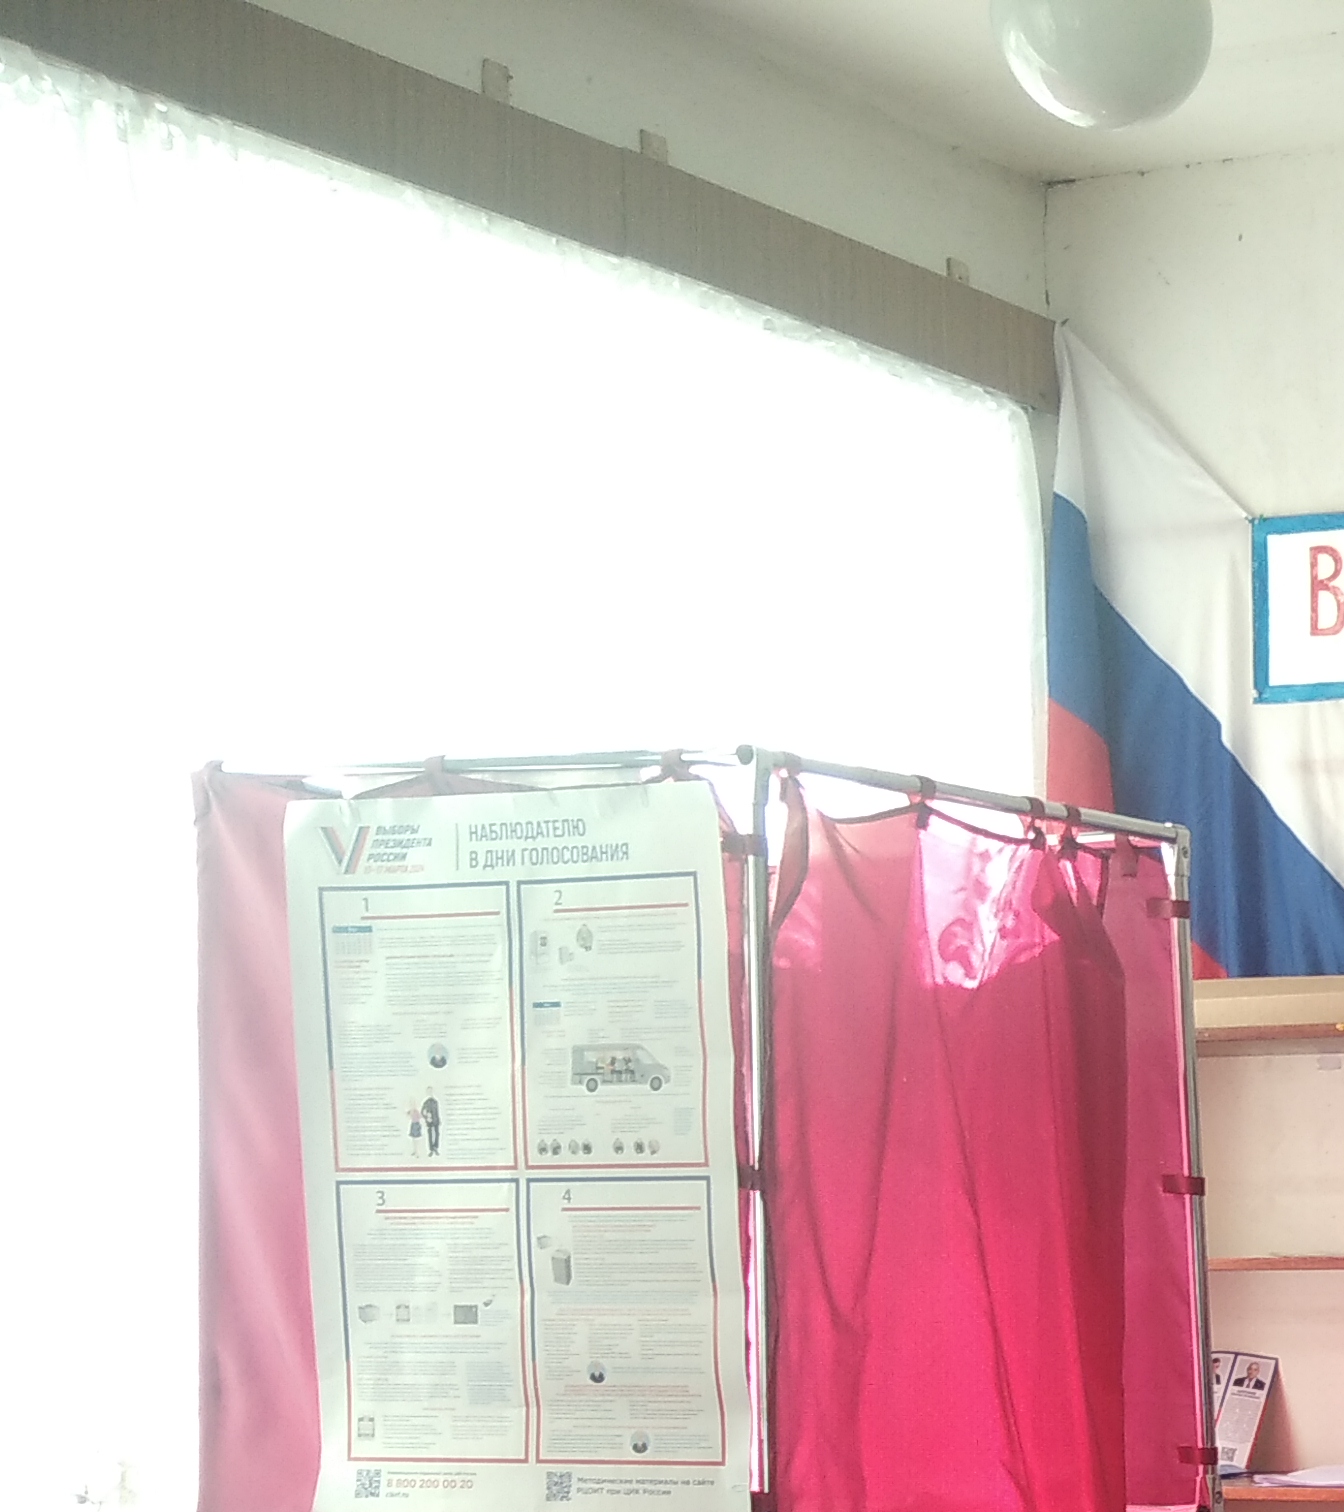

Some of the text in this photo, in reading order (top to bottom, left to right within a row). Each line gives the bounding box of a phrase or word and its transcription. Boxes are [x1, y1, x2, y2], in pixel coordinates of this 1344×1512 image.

[468, 818, 586, 842] НАБЛЮДАТЕЛЮ
[469, 842, 630, 871] В ДНИ ГОЛОСОВАНИЯ
[361, 896, 370, 913] 1
[553, 889, 563, 906] 2
[375, 1190, 386, 1207] 3
[561, 1188, 572, 1204] 4
